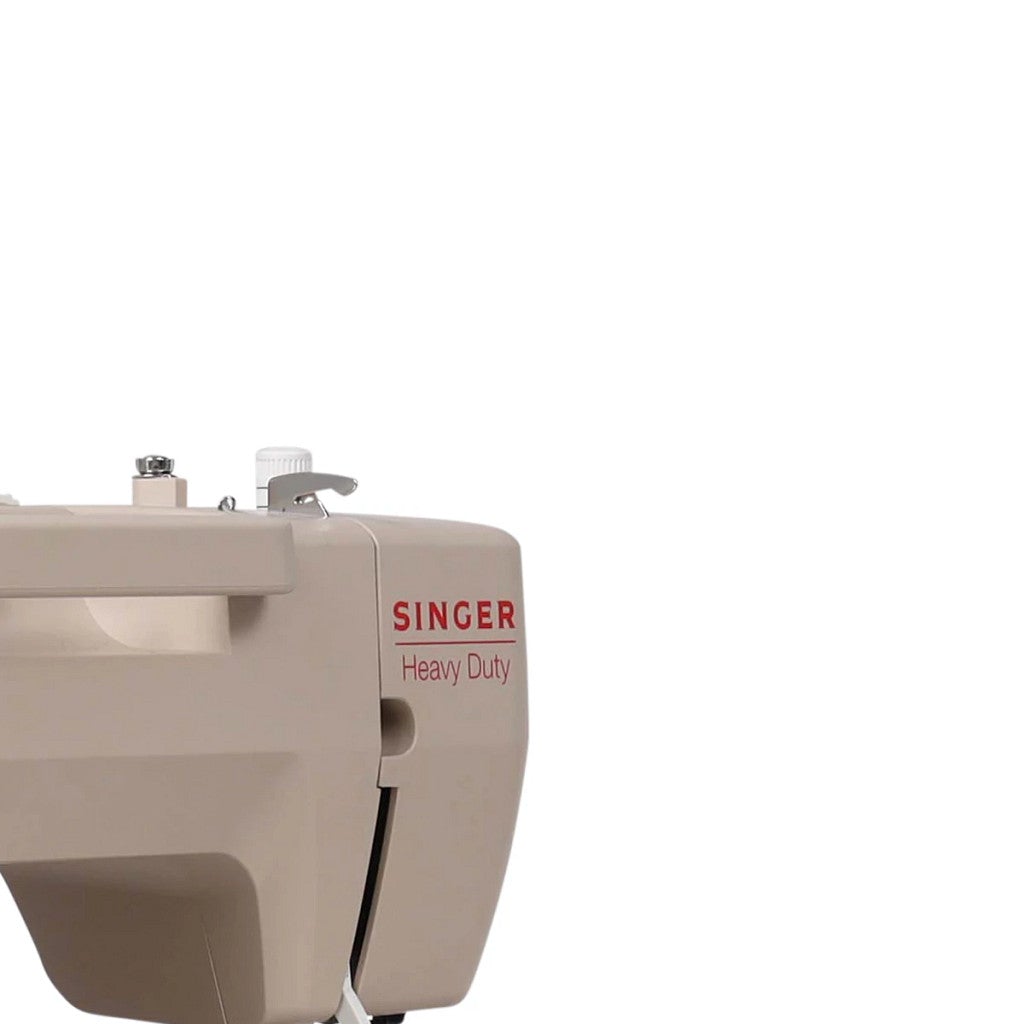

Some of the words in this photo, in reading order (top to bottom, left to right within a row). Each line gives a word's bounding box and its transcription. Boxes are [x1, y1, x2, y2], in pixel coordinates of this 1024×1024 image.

[393, 600, 516, 631] SINGER
[402, 654, 461, 686] Heavy
[467, 652, 511, 685] Duty
